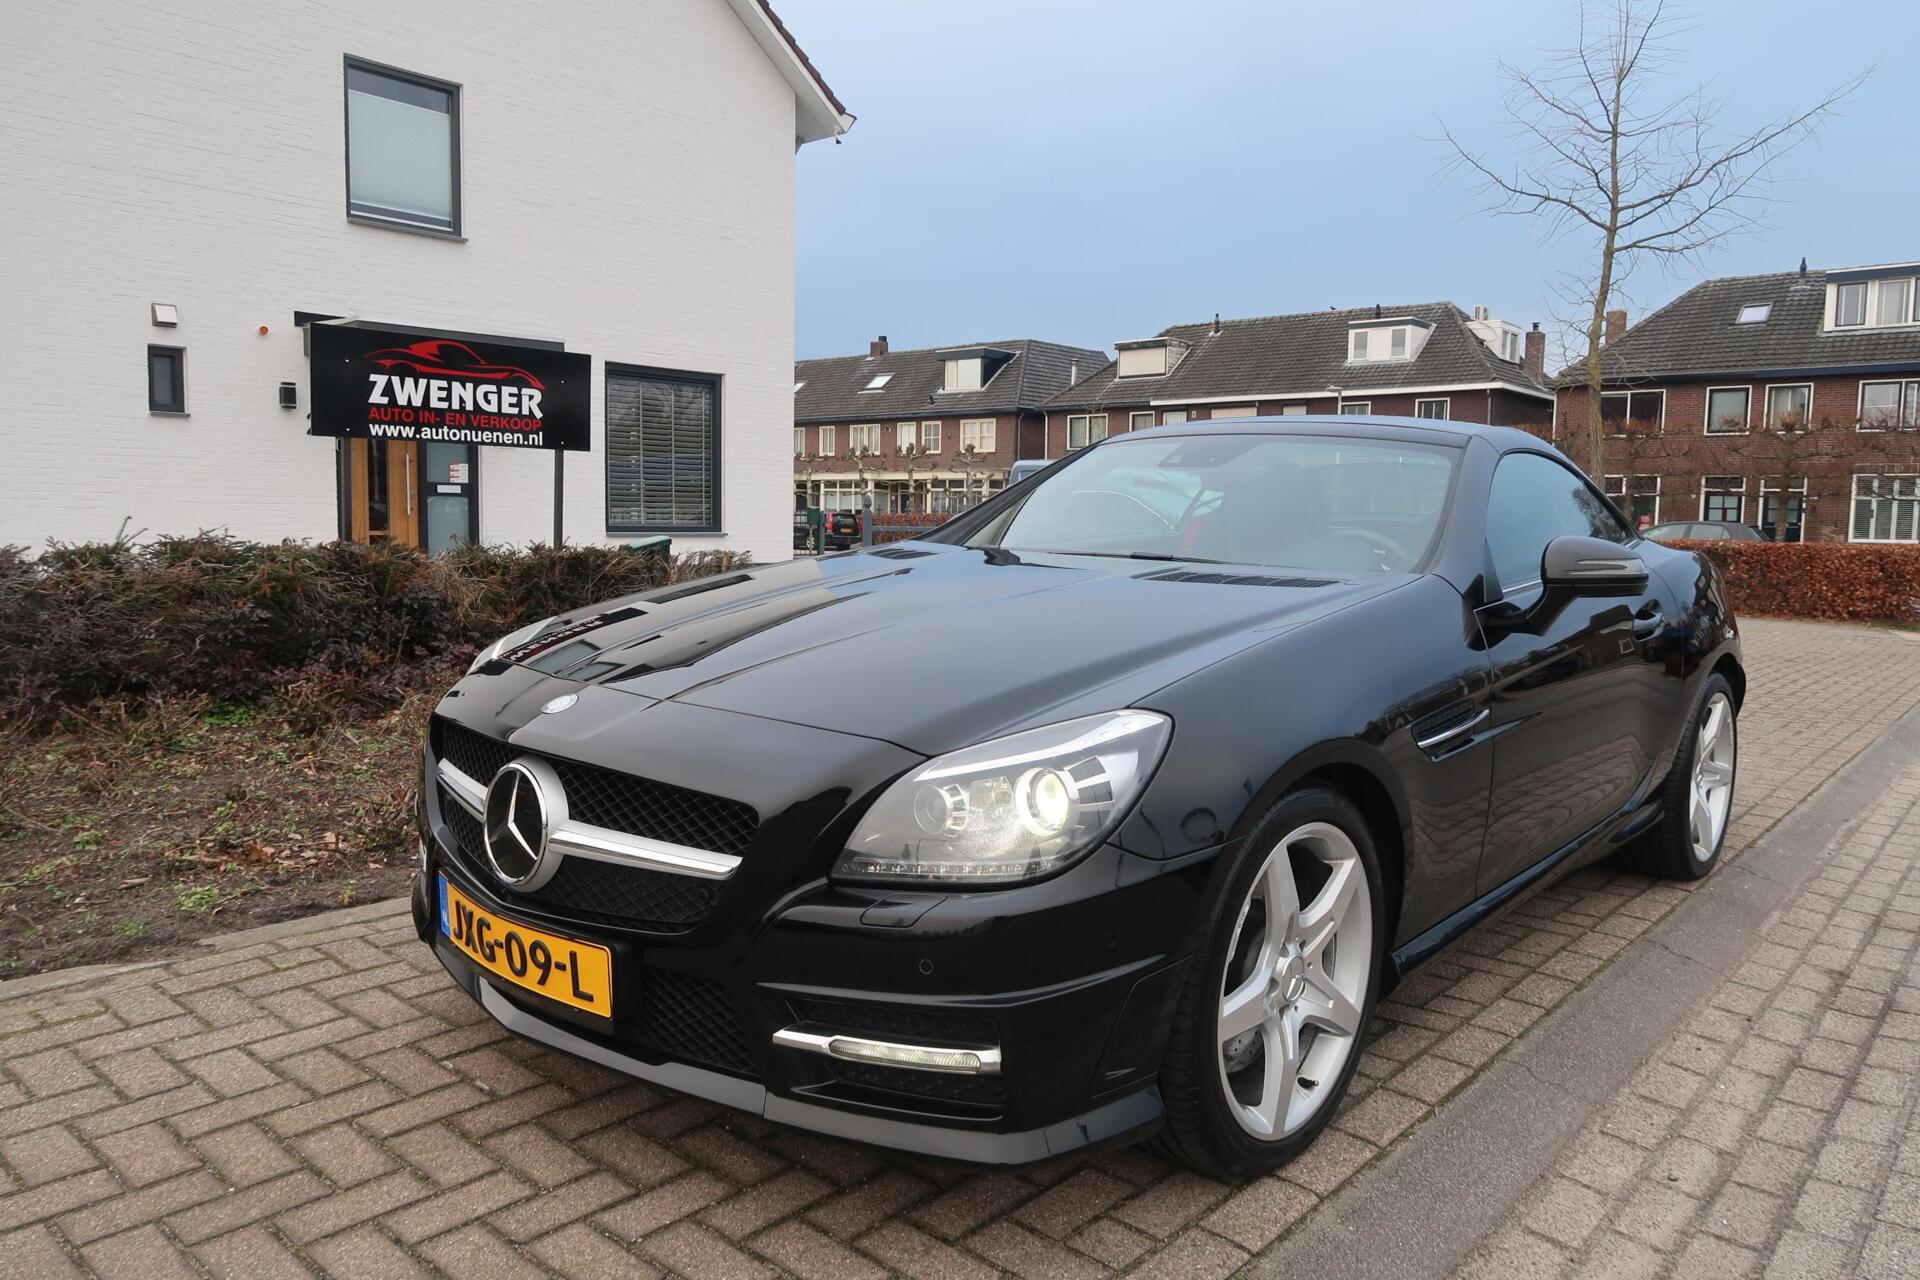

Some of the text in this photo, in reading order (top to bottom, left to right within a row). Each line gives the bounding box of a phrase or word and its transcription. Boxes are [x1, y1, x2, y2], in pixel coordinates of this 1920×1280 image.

[368, 373, 544, 420] ZWENGER
[368, 406, 543, 431] AUTO IN- EN VERKOOP
[368, 423, 543, 446] www.autonuenen.nl
[453, 899, 594, 1002] JXG-09-L
